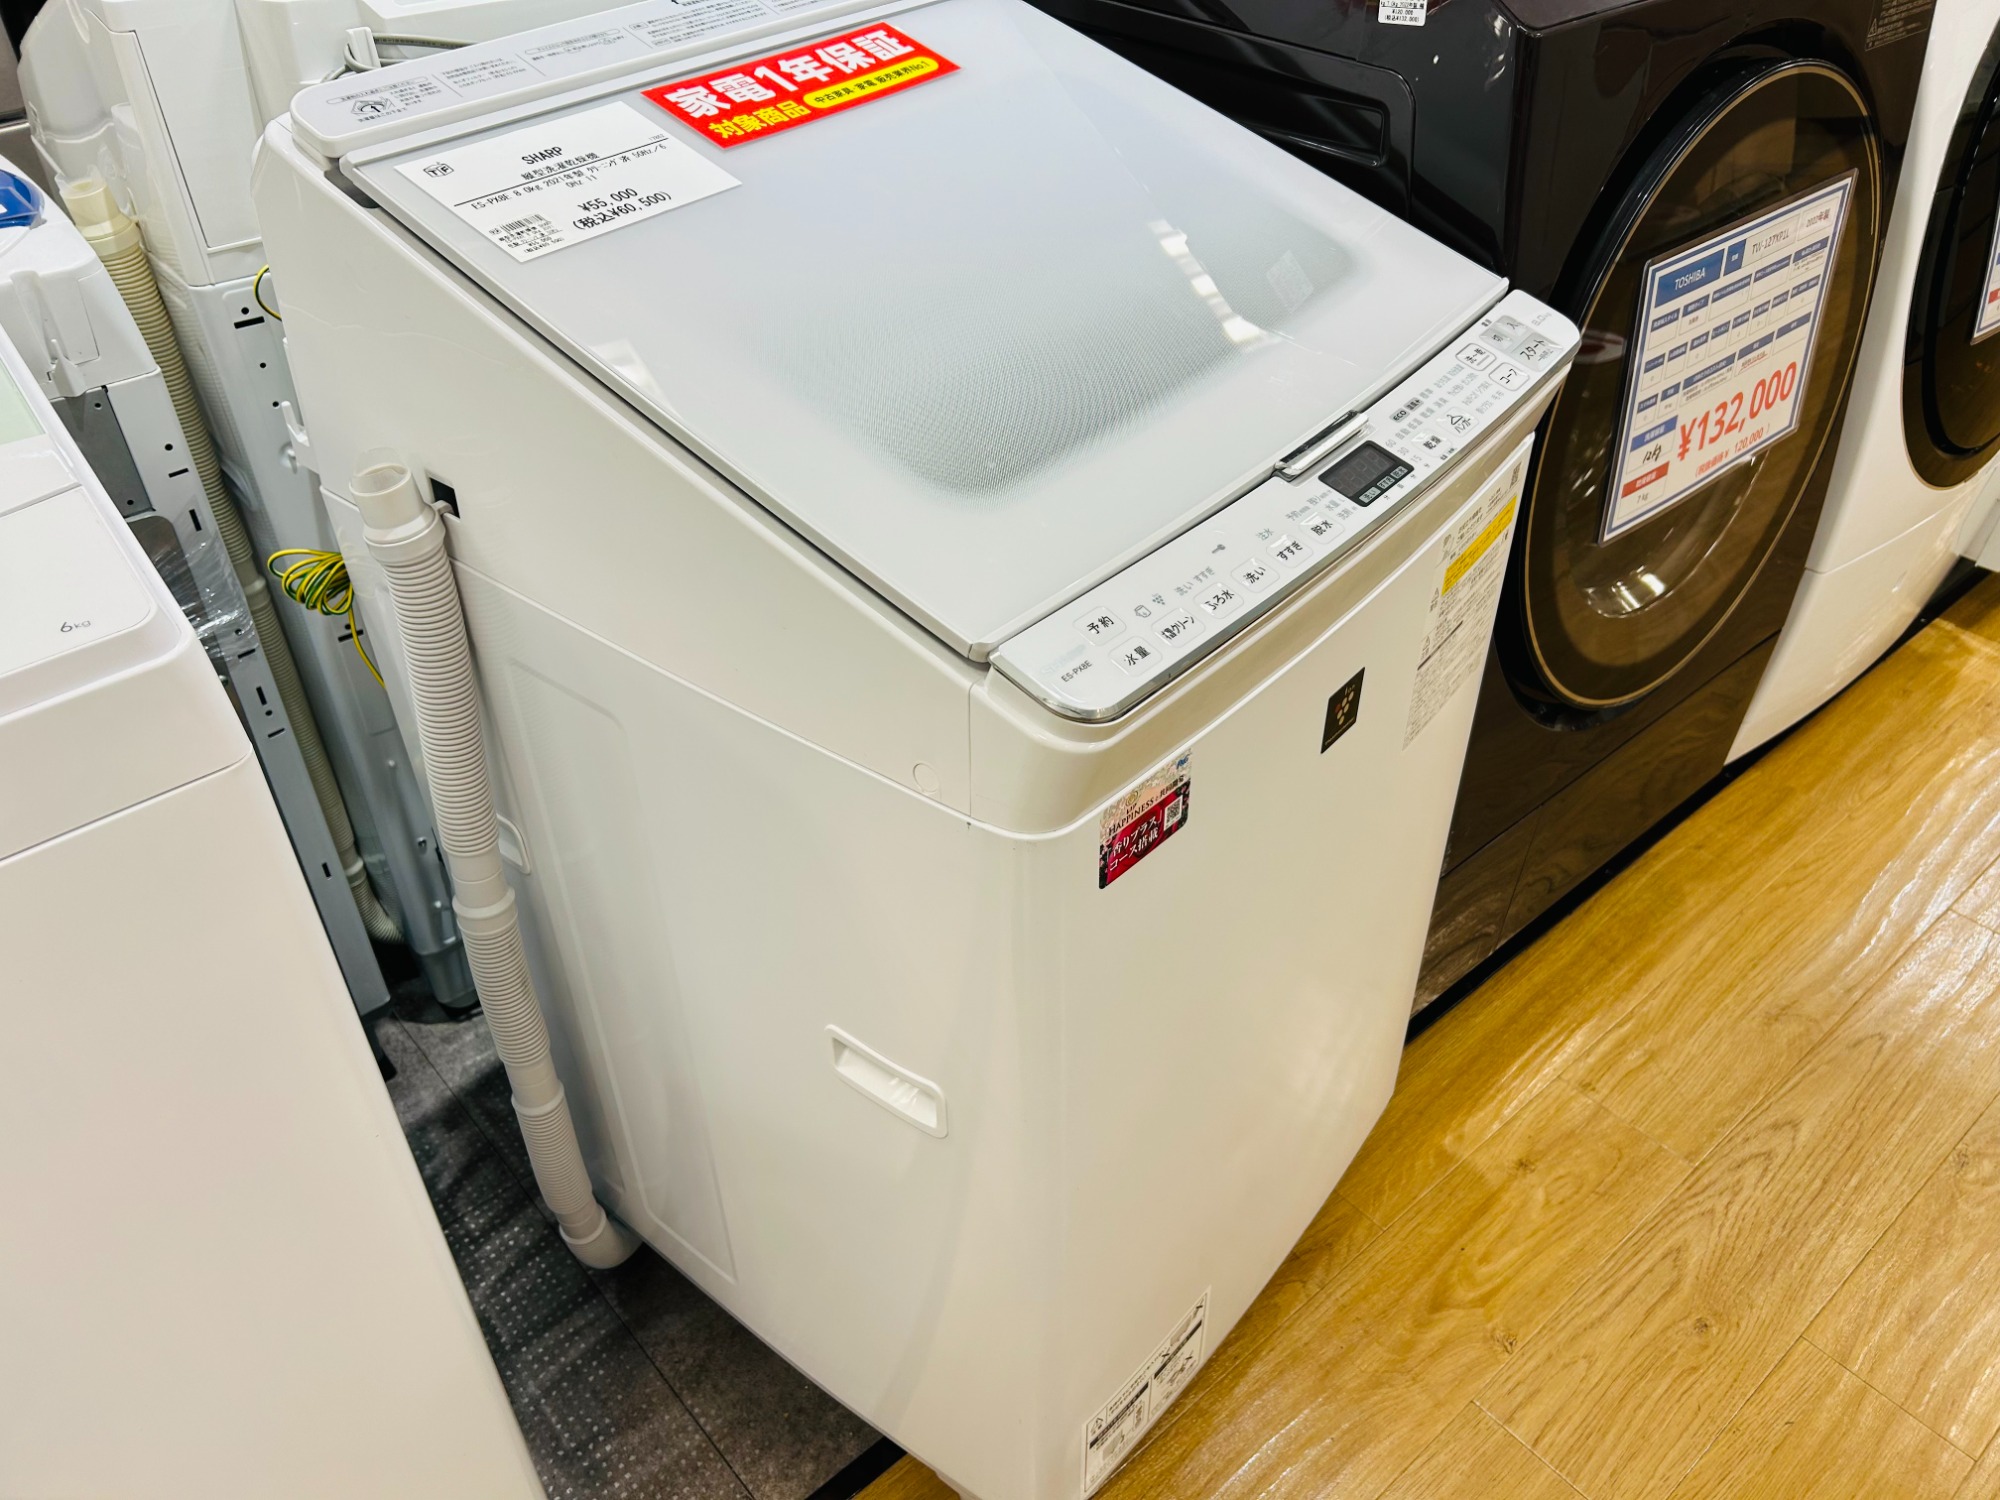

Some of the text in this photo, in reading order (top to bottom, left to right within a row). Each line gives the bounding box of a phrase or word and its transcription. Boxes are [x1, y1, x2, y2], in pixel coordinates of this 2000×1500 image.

[664, 29, 915, 119] 家電1年保証
[709, 100, 812, 139] 対象商品
[522, 146, 563, 165] SHARP
[470, 192, 512, 210] ES-PX8E
[543, 171, 585, 190] 2021年製
[577, 188, 638, 212] ¥55,000
[573, 191, 672, 230] (税込¥60,500)
[1674, 267, 1706, 291] TOSHIBA
[1520, 338, 1547, 361] スタート
[1393, 410, 1407, 421] ECO
[1678, 361, 1797, 461] ¥132,000
[1311, 520, 1333, 536] 脱水
[1276, 540, 1304, 562] すすぎ
[1243, 566, 1266, 584] 洗い
[1204, 589, 1235, 611] ふろ水
[60, 620, 92, 633] 6kg
[1087, 614, 1114, 635] 予約
[1124, 645, 1151, 667] 水量
[1061, 659, 1093, 683] ES-PX8E
[1108, 796, 1154, 837] HAPPINESS
[1109, 827, 1160, 872] コース搭載
